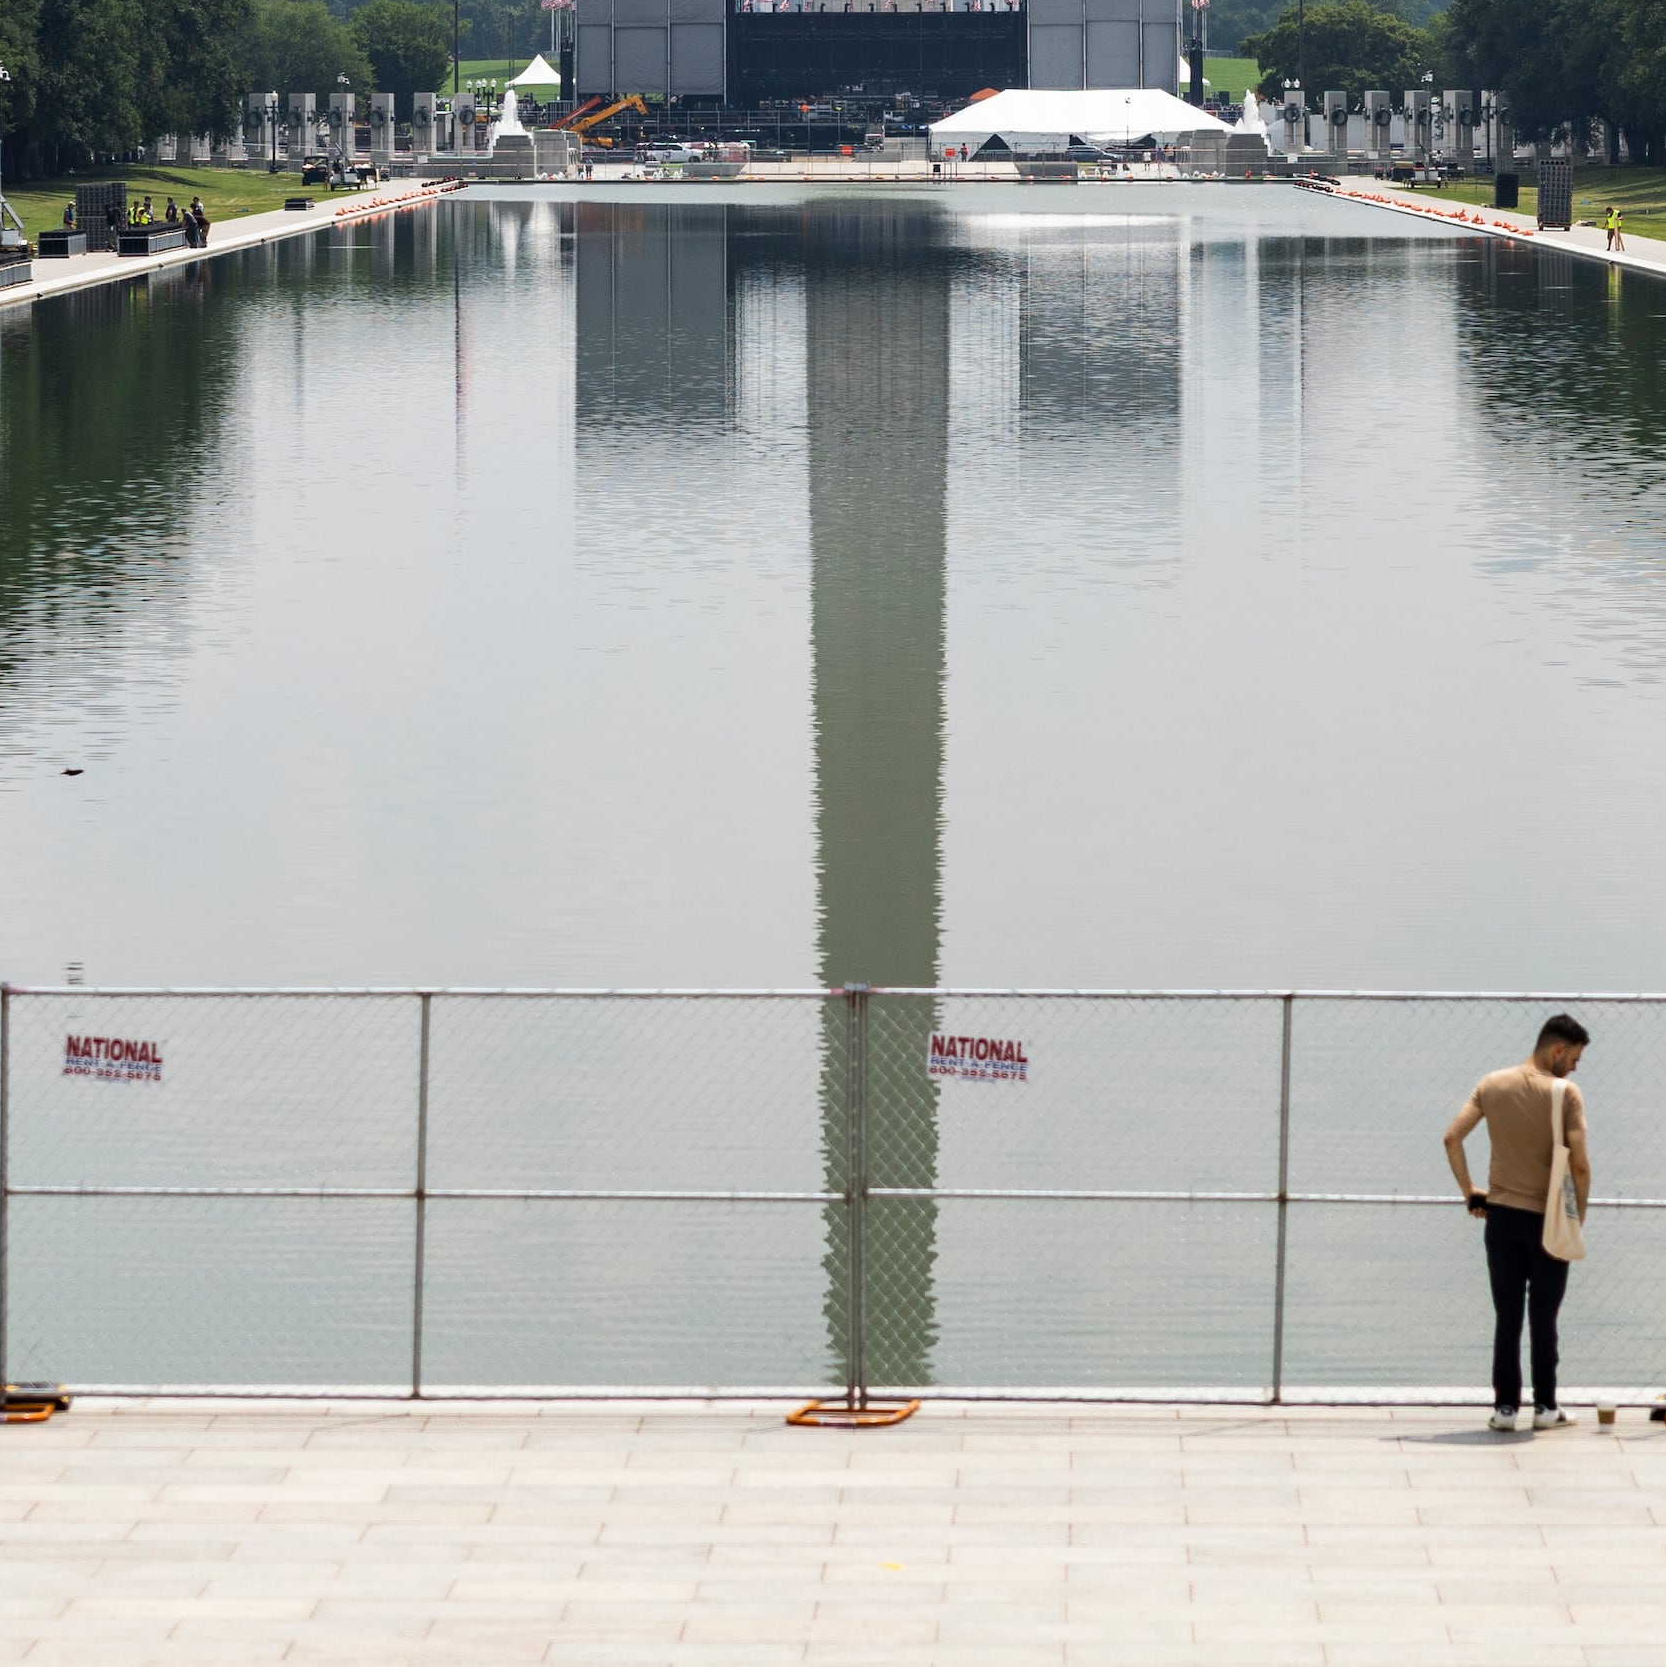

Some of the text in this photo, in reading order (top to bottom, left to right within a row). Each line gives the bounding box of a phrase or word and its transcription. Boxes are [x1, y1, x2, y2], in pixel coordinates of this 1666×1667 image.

[66, 1035, 162, 1063] NATIONAL
[931, 1035, 1028, 1062] NATIONAL
[65, 1057, 162, 1071] RENT-A-FENCE
[930, 1057, 1028, 1071] RENT-A-FENCE
